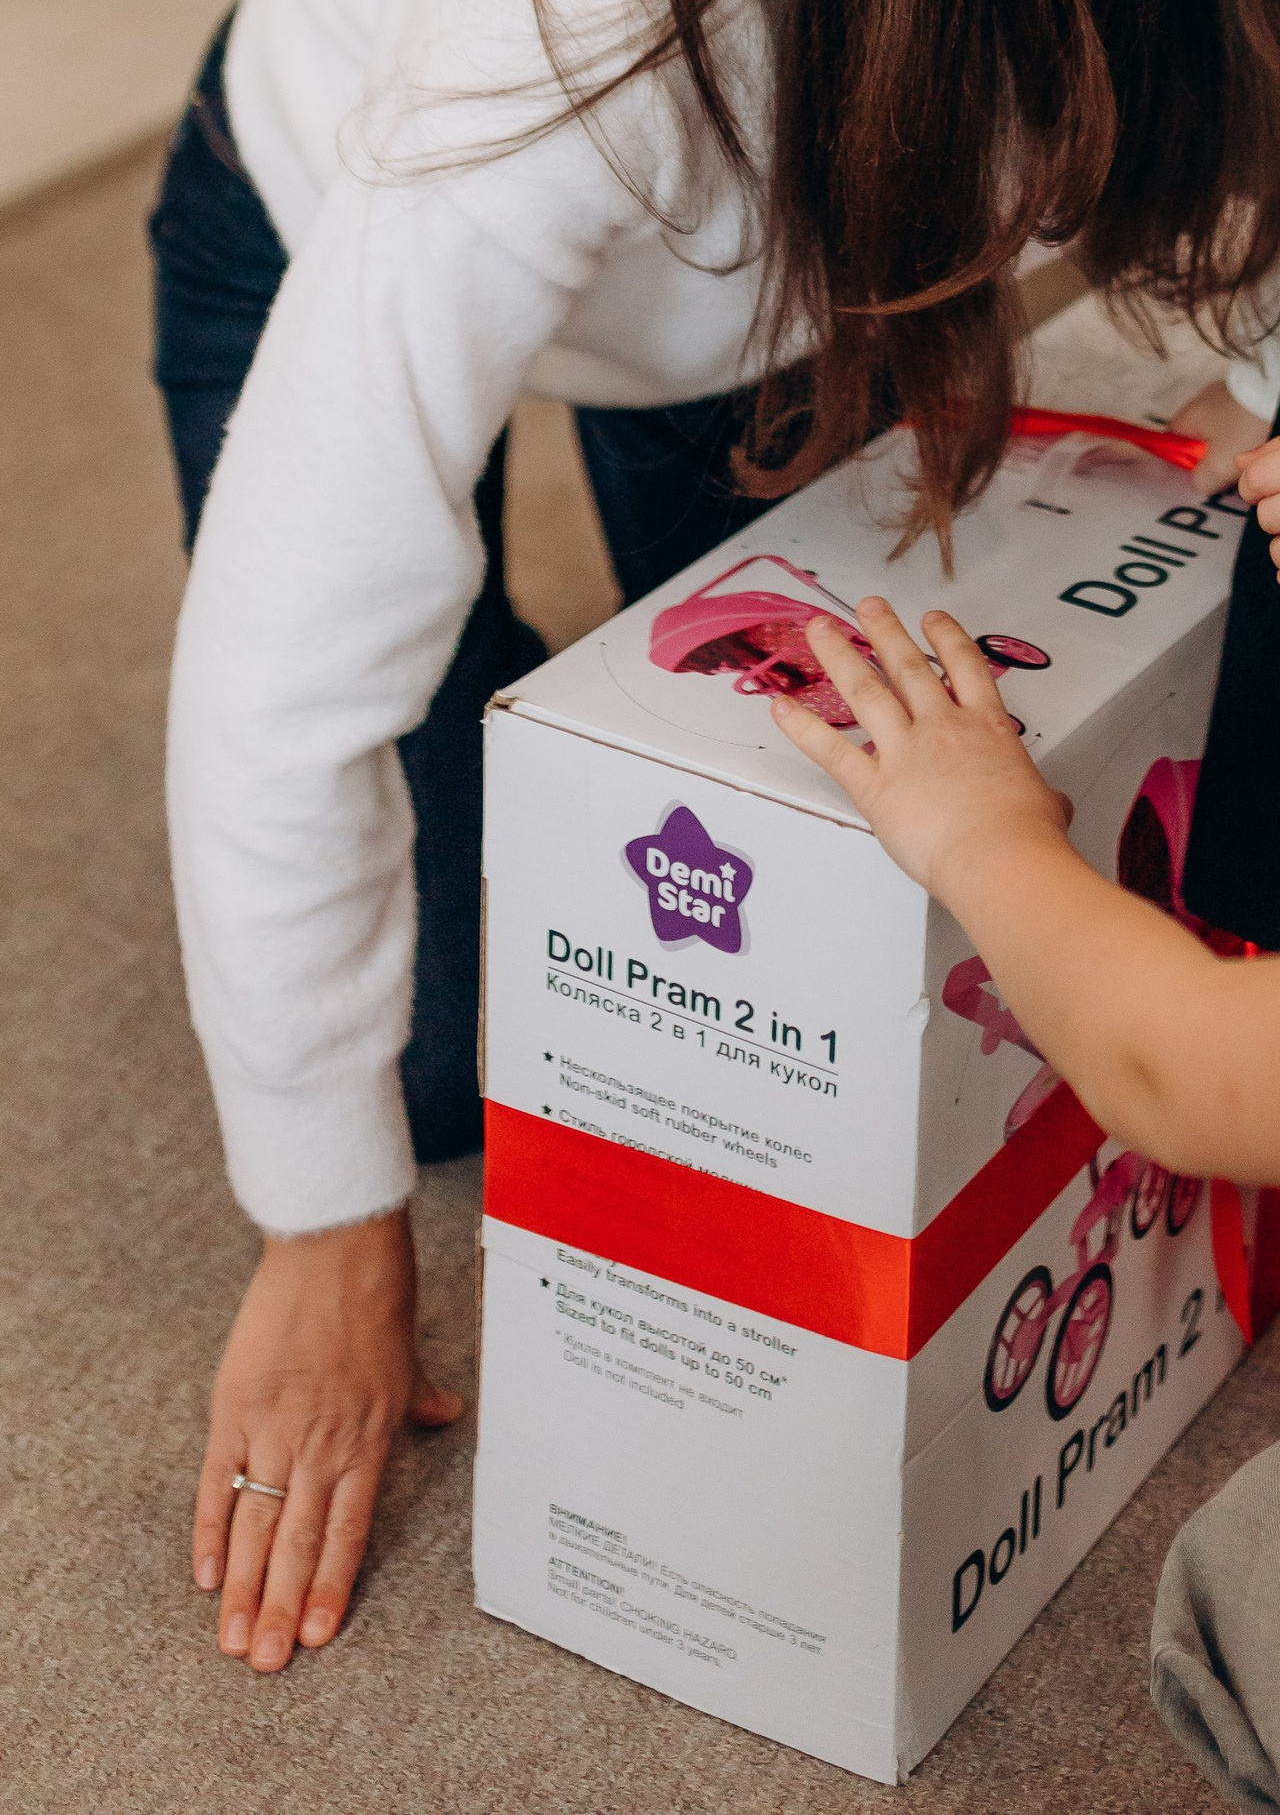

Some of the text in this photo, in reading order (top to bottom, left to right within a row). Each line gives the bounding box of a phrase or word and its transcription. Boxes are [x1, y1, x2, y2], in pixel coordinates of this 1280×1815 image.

[1057, 483, 1250, 619] Doll Pr
[645, 846, 736, 903] Demi
[656, 881, 727, 928] Star
[546, 972, 838, 1098] Коляска 2 в 1 для кукол
[547, 928, 838, 1064] Doll Pram 2 in 1
[558, 1109, 607, 1138] Стиль
[559, 1073, 777, 1169] Non-skid soft rubber wheels
[560, 1055, 677, 1110] Нескользящее
[681, 1104, 760, 1142] покрытие
[555, 1300, 773, 1402] Sized to fit dolls up to 50 cm
[556, 1248, 601, 1278] Easily
[606, 1269, 689, 1312] transforms
[693, 1304, 723, 1326] into
[727, 1321, 737, 1333] a
[741, 1327, 798, 1357] stroller
[556, 1283, 586, 1305] Для
[591, 1300, 634, 1325] кукол
[637, 1320, 707, 1355] высотой
[710, 1350, 731, 1366] до
[735, 1357, 755, 1375] 50
[950, 1287, 1202, 1634] Doll Pram 2
